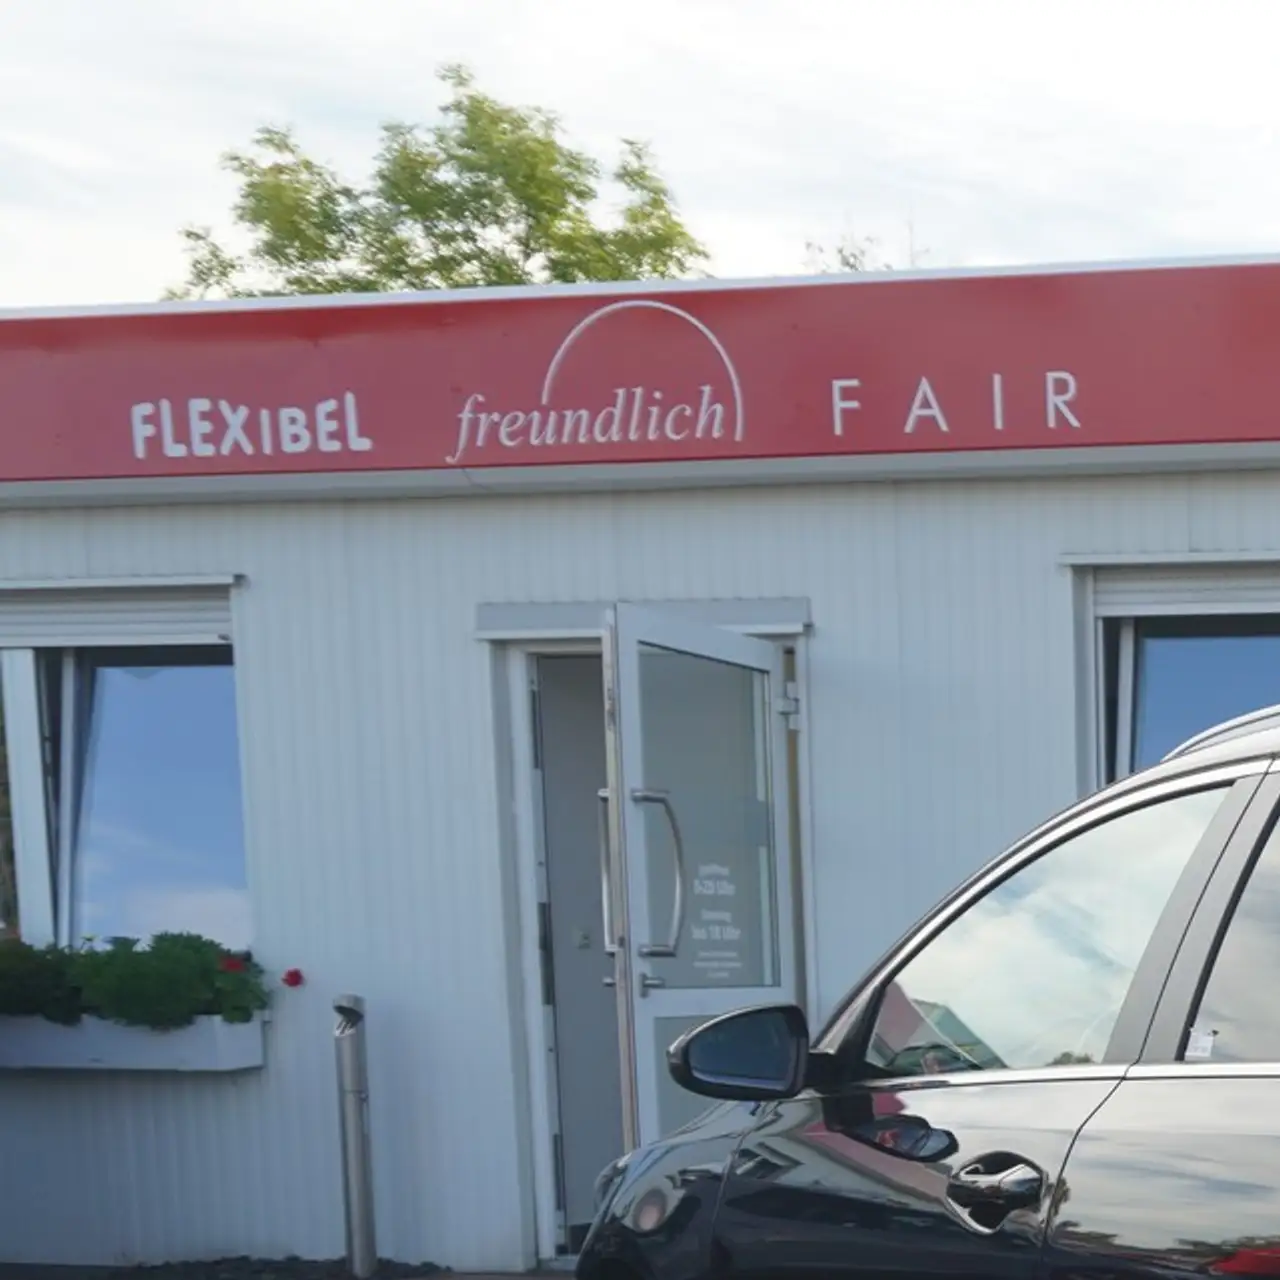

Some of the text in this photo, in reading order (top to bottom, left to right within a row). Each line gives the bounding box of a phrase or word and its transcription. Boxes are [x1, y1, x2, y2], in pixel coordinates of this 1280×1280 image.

[132, 392, 371, 459] FLEXIBEL
[446, 385, 727, 463] freundlich
[832, 371, 1081, 436] FAIR
